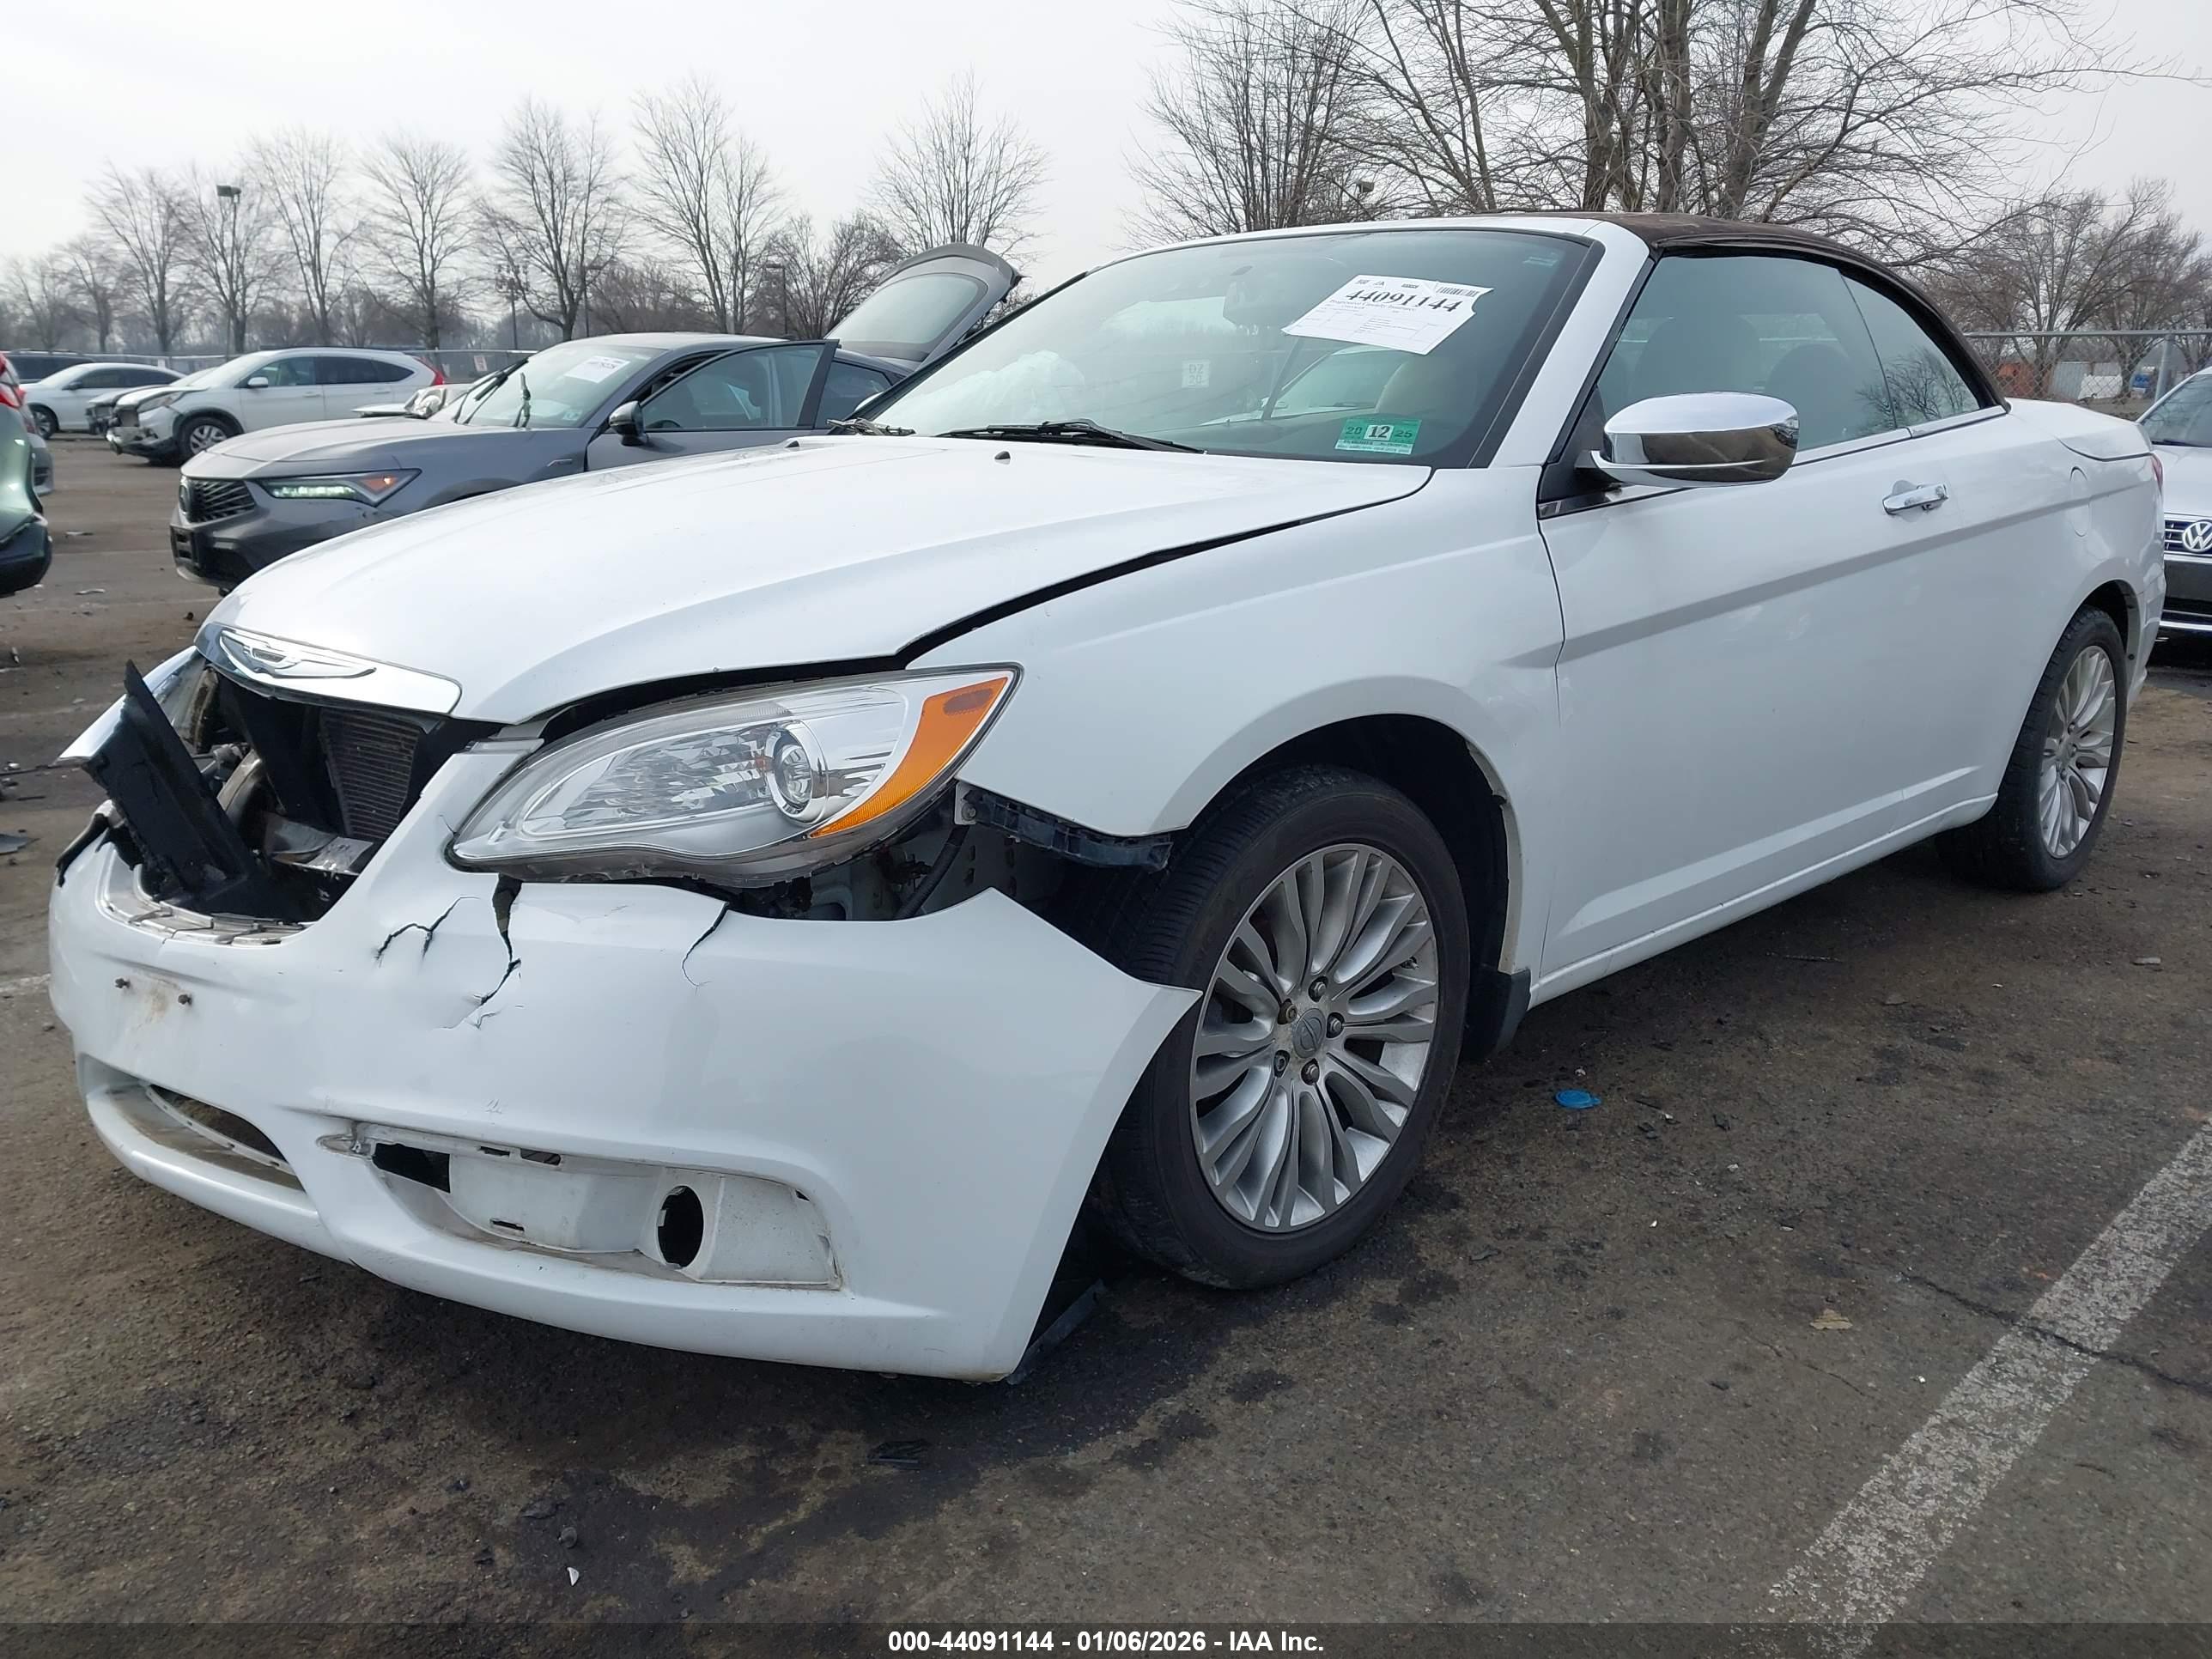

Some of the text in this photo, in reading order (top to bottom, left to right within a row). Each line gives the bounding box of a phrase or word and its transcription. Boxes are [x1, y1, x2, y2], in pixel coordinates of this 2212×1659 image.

[1346, 289, 1463, 313] 44091144
[1346, 426, 1363, 434] 20
[1368, 425, 1391, 438] 12
